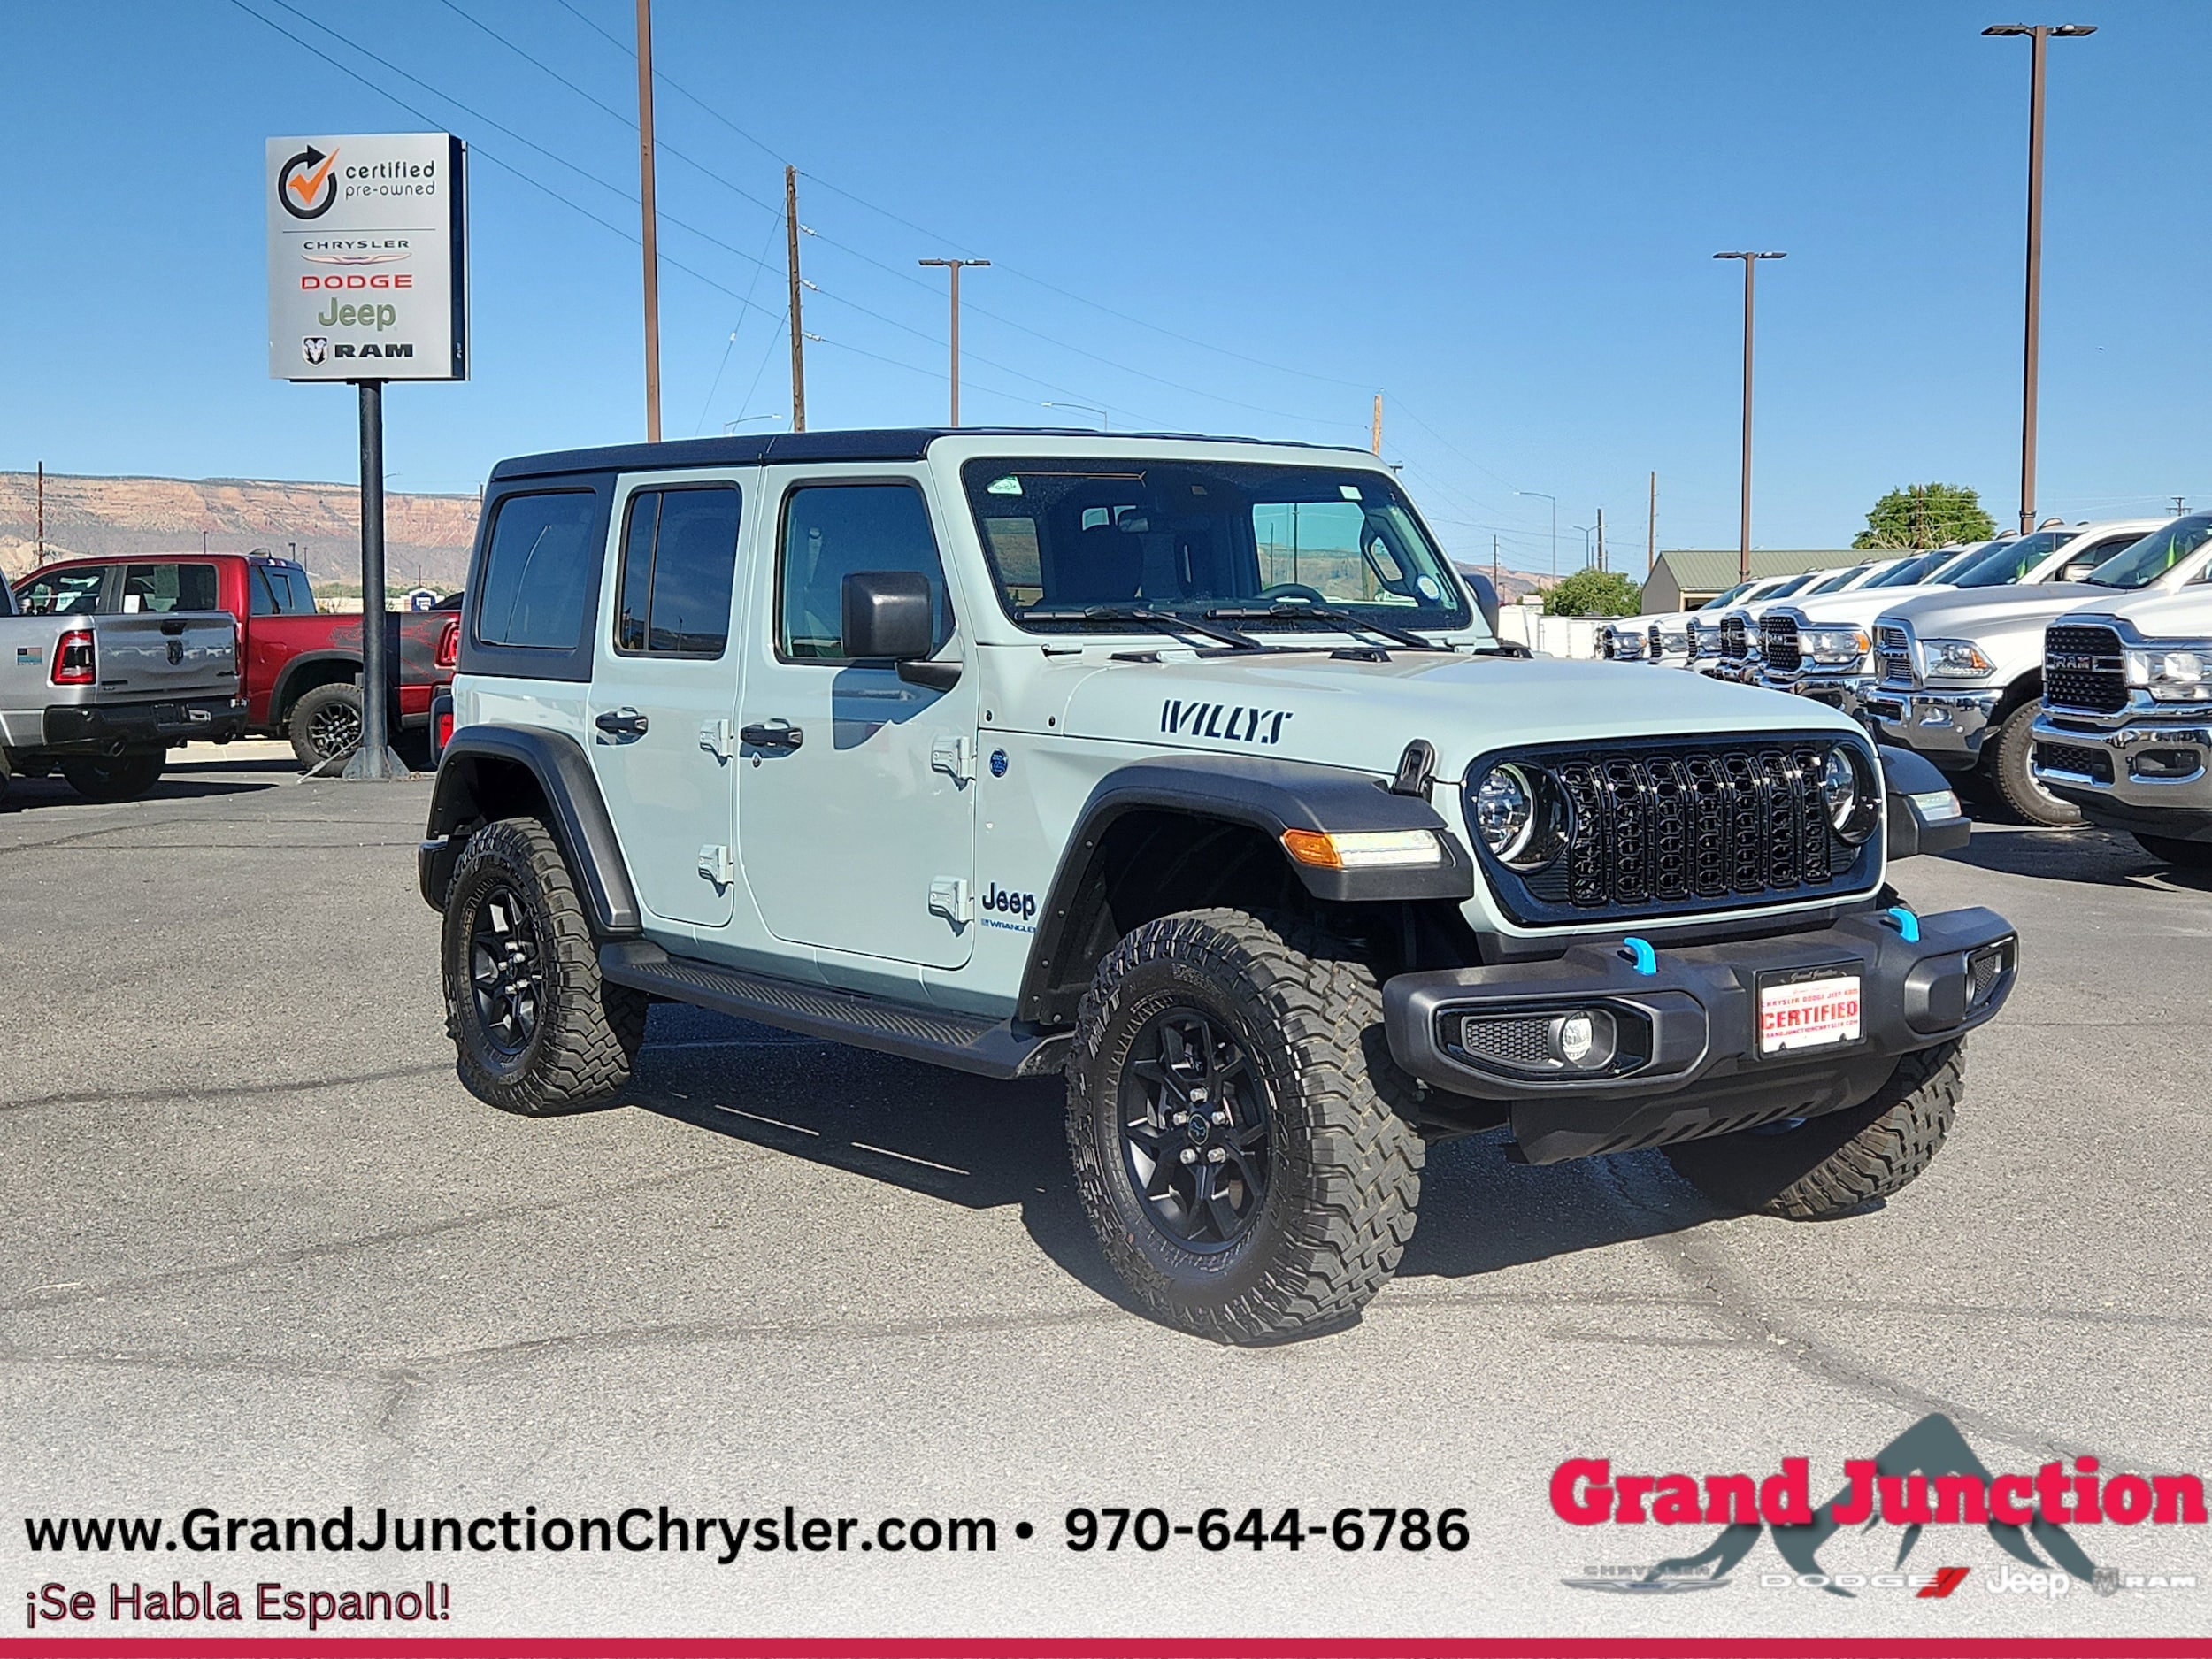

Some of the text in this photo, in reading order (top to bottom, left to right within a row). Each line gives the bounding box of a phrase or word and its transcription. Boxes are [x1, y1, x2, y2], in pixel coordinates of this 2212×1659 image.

[345, 160, 435, 179] certified
[345, 181, 435, 200] pre-owned
[303, 240, 410, 250] CHRYSLER
[301, 274, 413, 289] DODGE
[318, 297, 396, 331] Jeep
[334, 343, 413, 357] RAM
[2055, 655, 2090, 669] RAM
[1160, 699, 1294, 745] WILLYS
[982, 882, 1037, 921] Jeep
[1762, 1000, 1858, 1030] CERTIFIED
